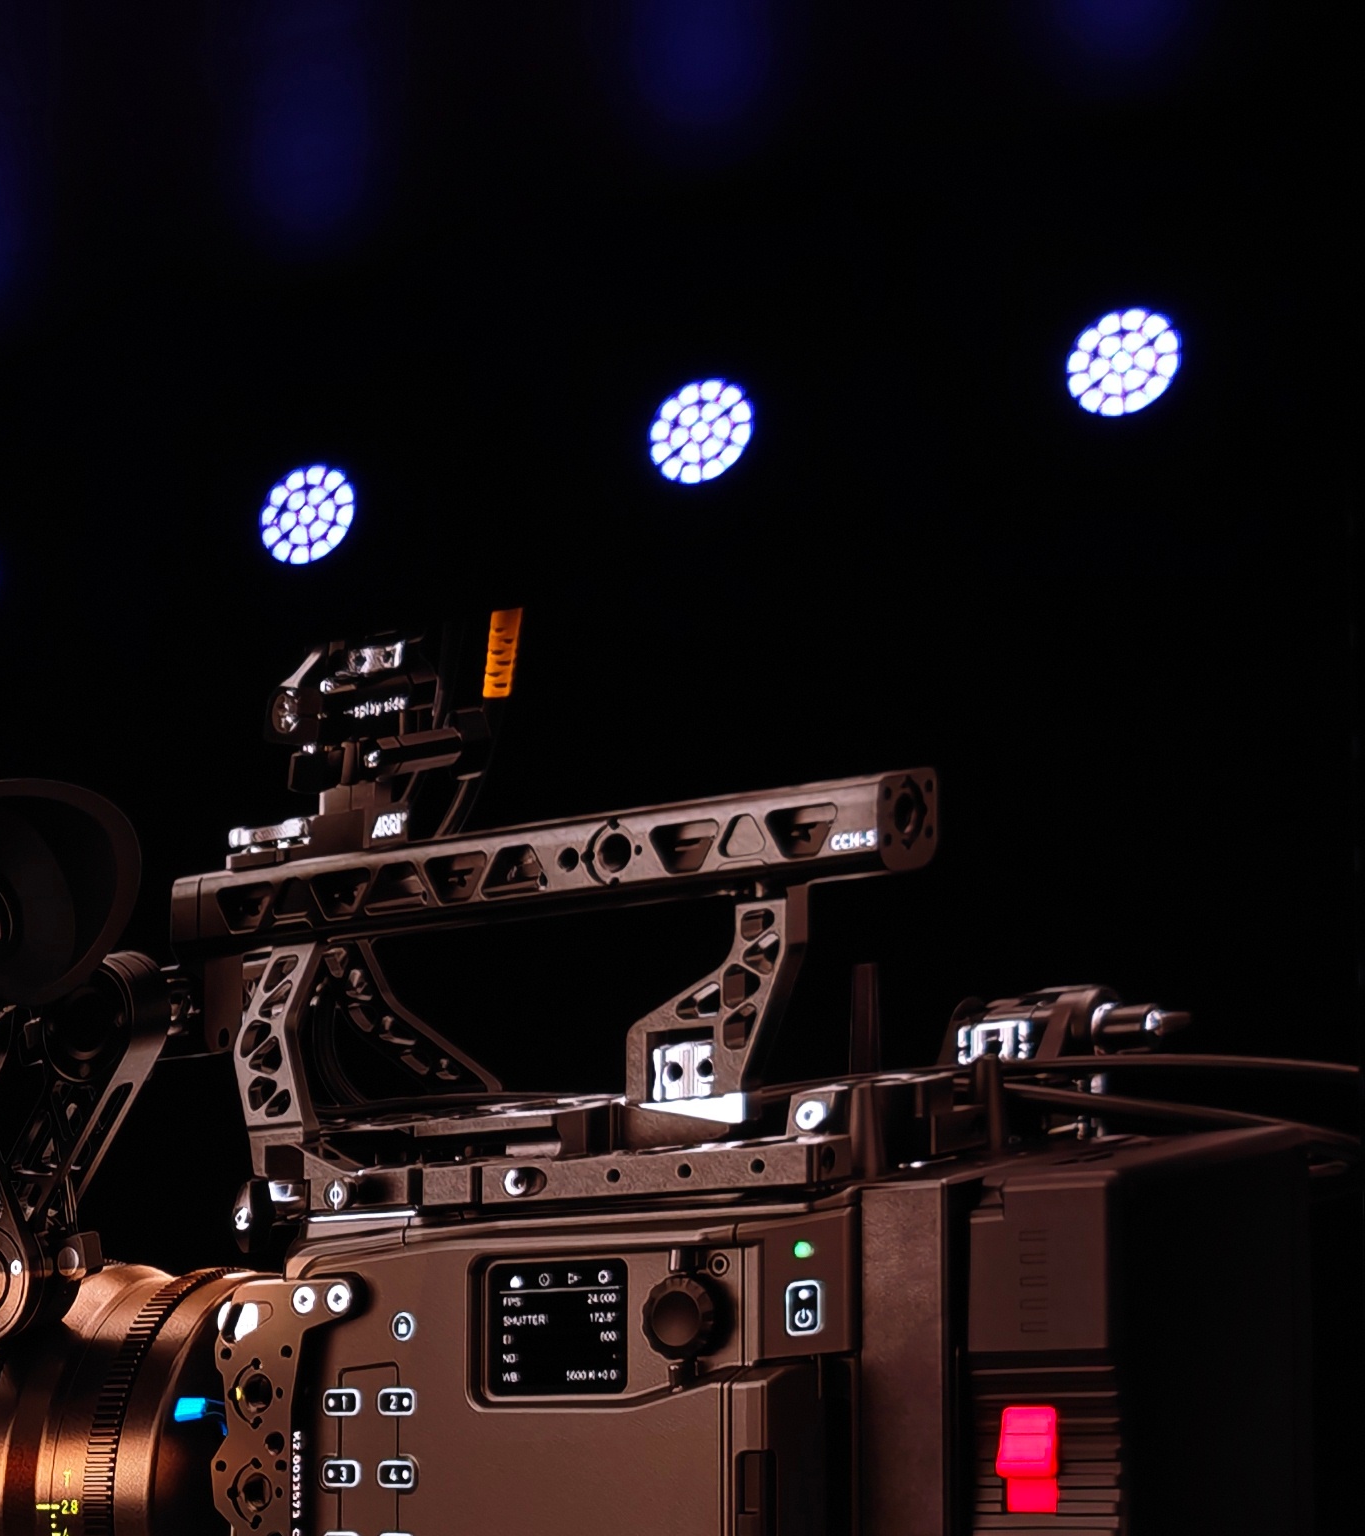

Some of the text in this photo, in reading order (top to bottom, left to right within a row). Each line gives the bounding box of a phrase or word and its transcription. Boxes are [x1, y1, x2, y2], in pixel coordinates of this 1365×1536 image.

[371, 813, 401, 838] ARRI
[389, 1394, 398, 1410] 2
[339, 1466, 398, 1482] 3 4
